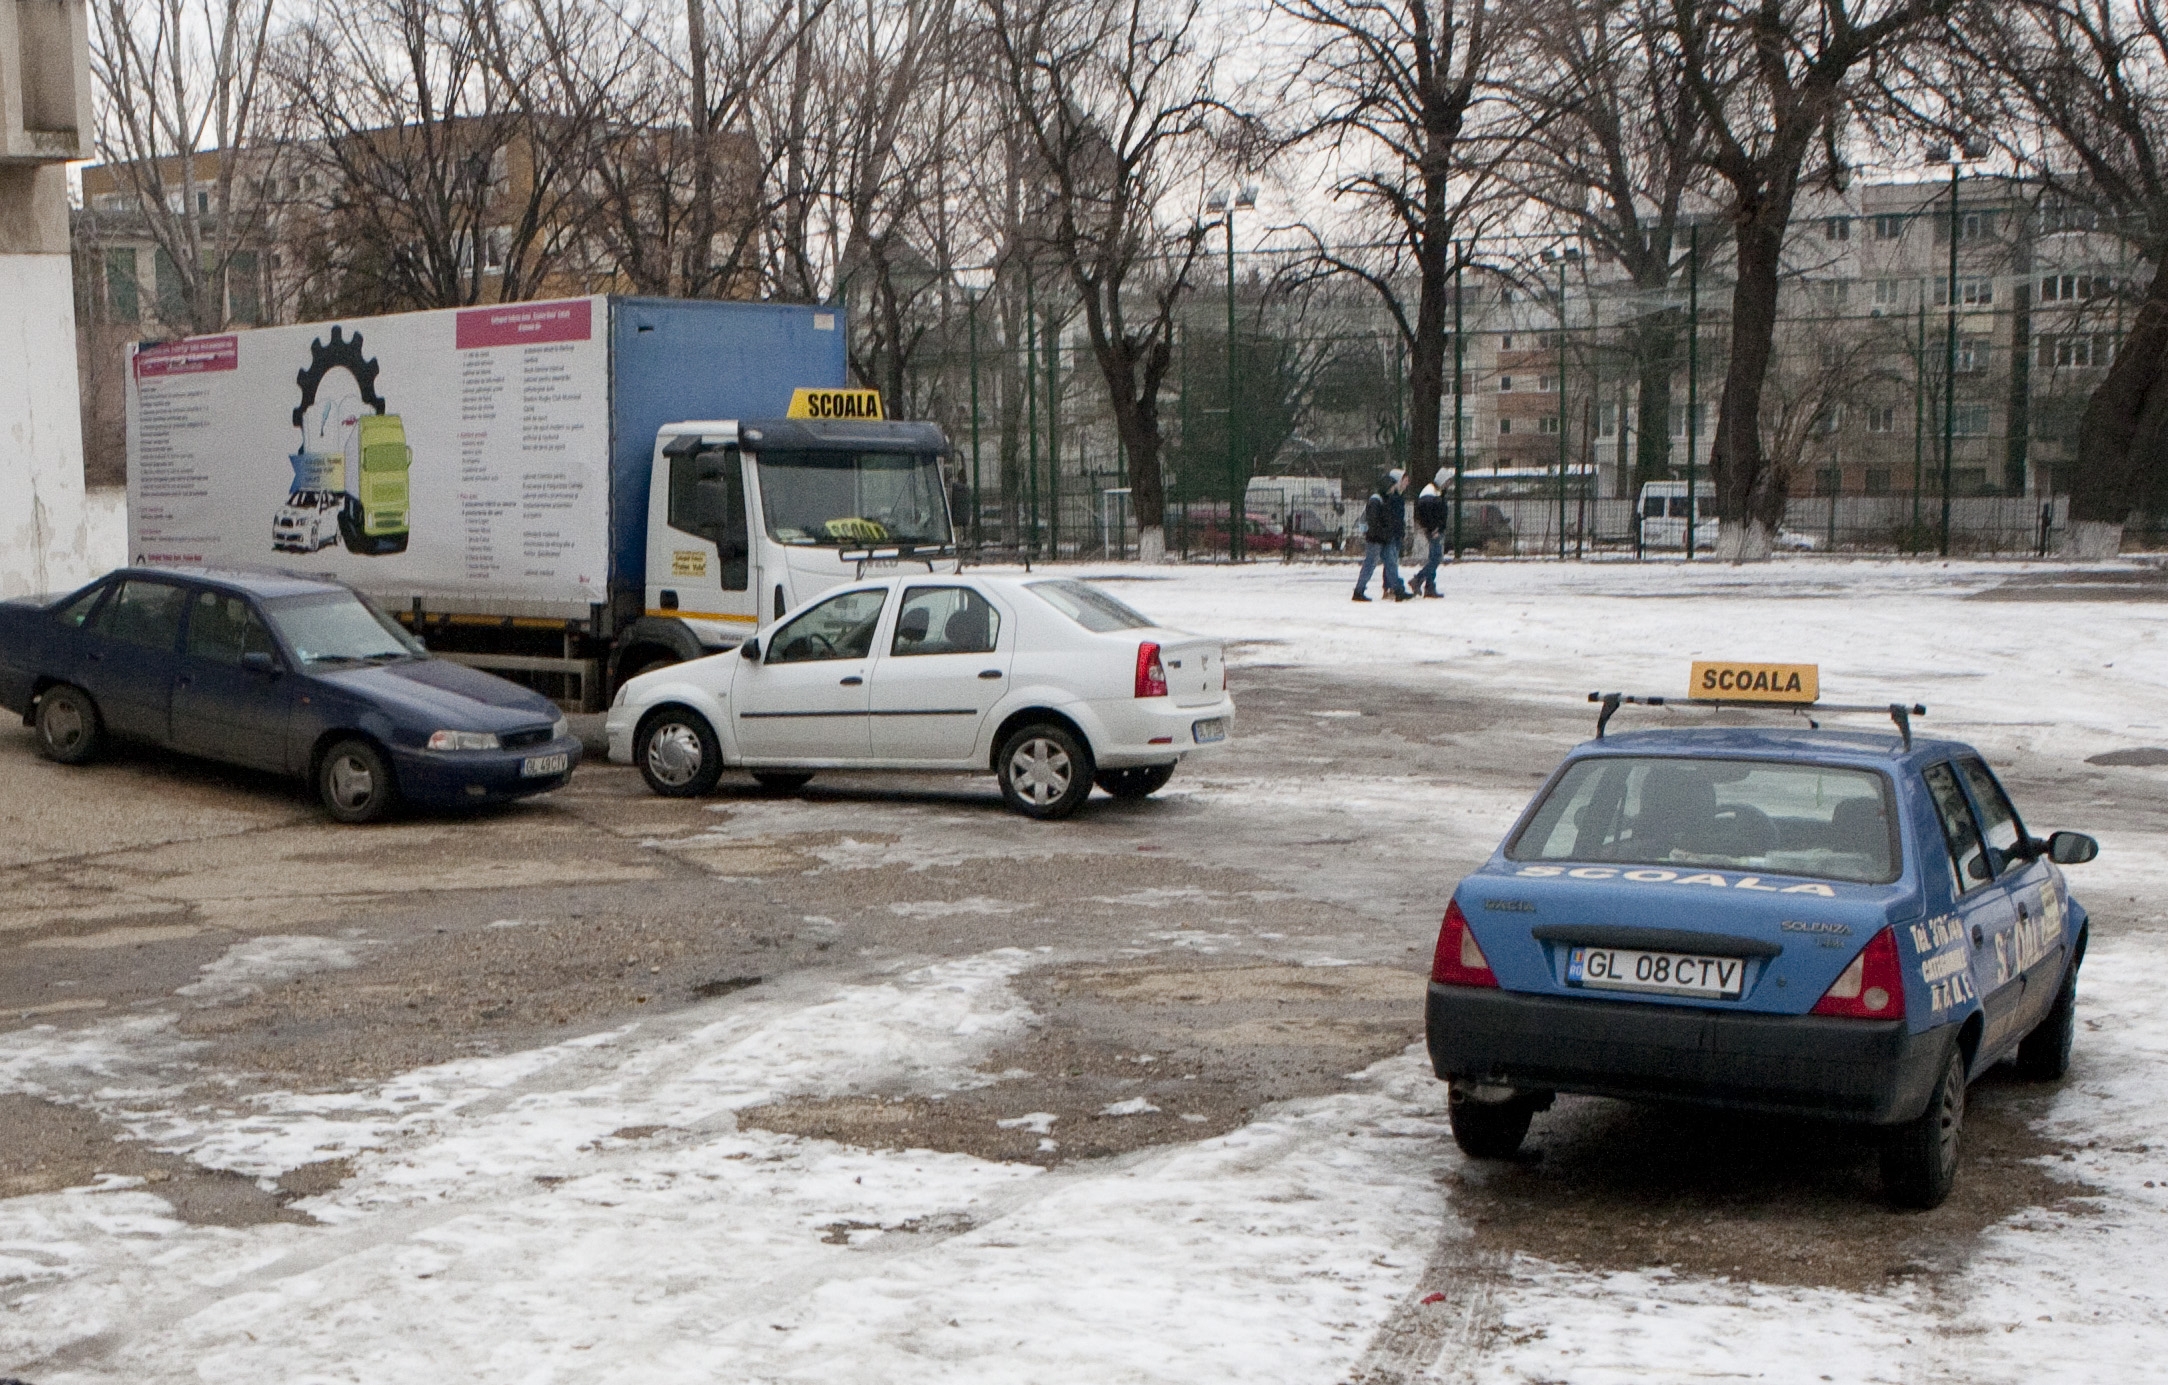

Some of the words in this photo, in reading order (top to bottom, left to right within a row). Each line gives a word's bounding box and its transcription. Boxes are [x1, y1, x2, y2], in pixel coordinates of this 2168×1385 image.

[808, 393, 878, 418] SCOALA
[1702, 669, 1801, 692] SCOALA
[1516, 866, 1836, 897] SCOALA
[1781, 920, 1853, 935] SOLENZA
[1587, 952, 1622, 979] GL
